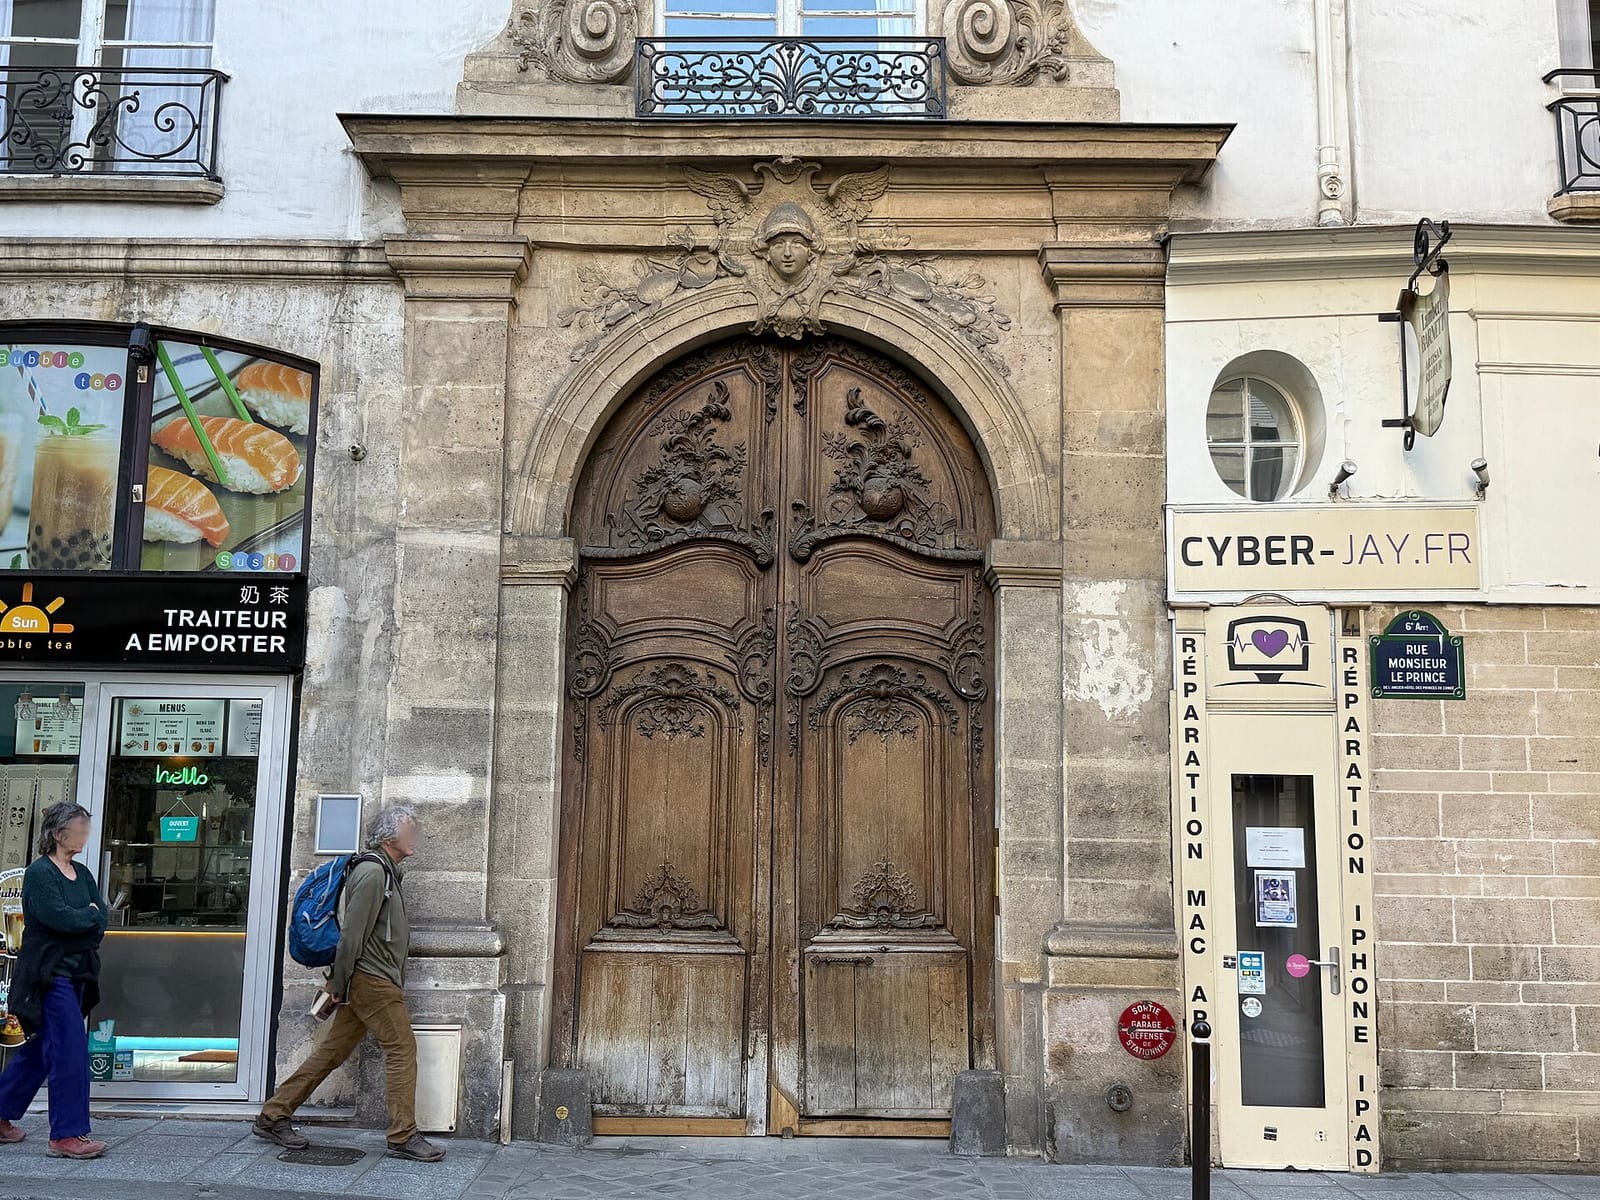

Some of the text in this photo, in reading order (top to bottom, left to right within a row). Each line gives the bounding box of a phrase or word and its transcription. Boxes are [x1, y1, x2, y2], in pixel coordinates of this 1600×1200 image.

[80, 375, 118, 389] tea
[1181, 533, 1472, 567] CYBER-JAY.FR
[219, 555, 290, 570] Sushi
[240, 585, 289, 604] 奶茶
[12, 616, 38, 628] Sun
[164, 609, 288, 628] TRAITEUR
[48, 640, 72, 650] tea
[126, 633, 286, 653] A EMPORTER
[1406, 644, 1429, 655] RUE
[1388, 658, 1447, 669] MONSIEUR
[1391, 671, 1447, 683] LE PRINCE
[159, 703, 186, 713] MENUS
[1182, 637, 1203, 859] RÉPARATION
[156, 764, 208, 785] hello
[1343, 647, 1372, 1167] RÉPARATION IPHONE IPAD
[1187, 890, 1206, 954] MAC
[1131, 1004, 1161, 1016] SORTIE
[1131, 1020, 1162, 1029] GARAGE
[1126, 1039, 1169, 1056] STATIONNER
